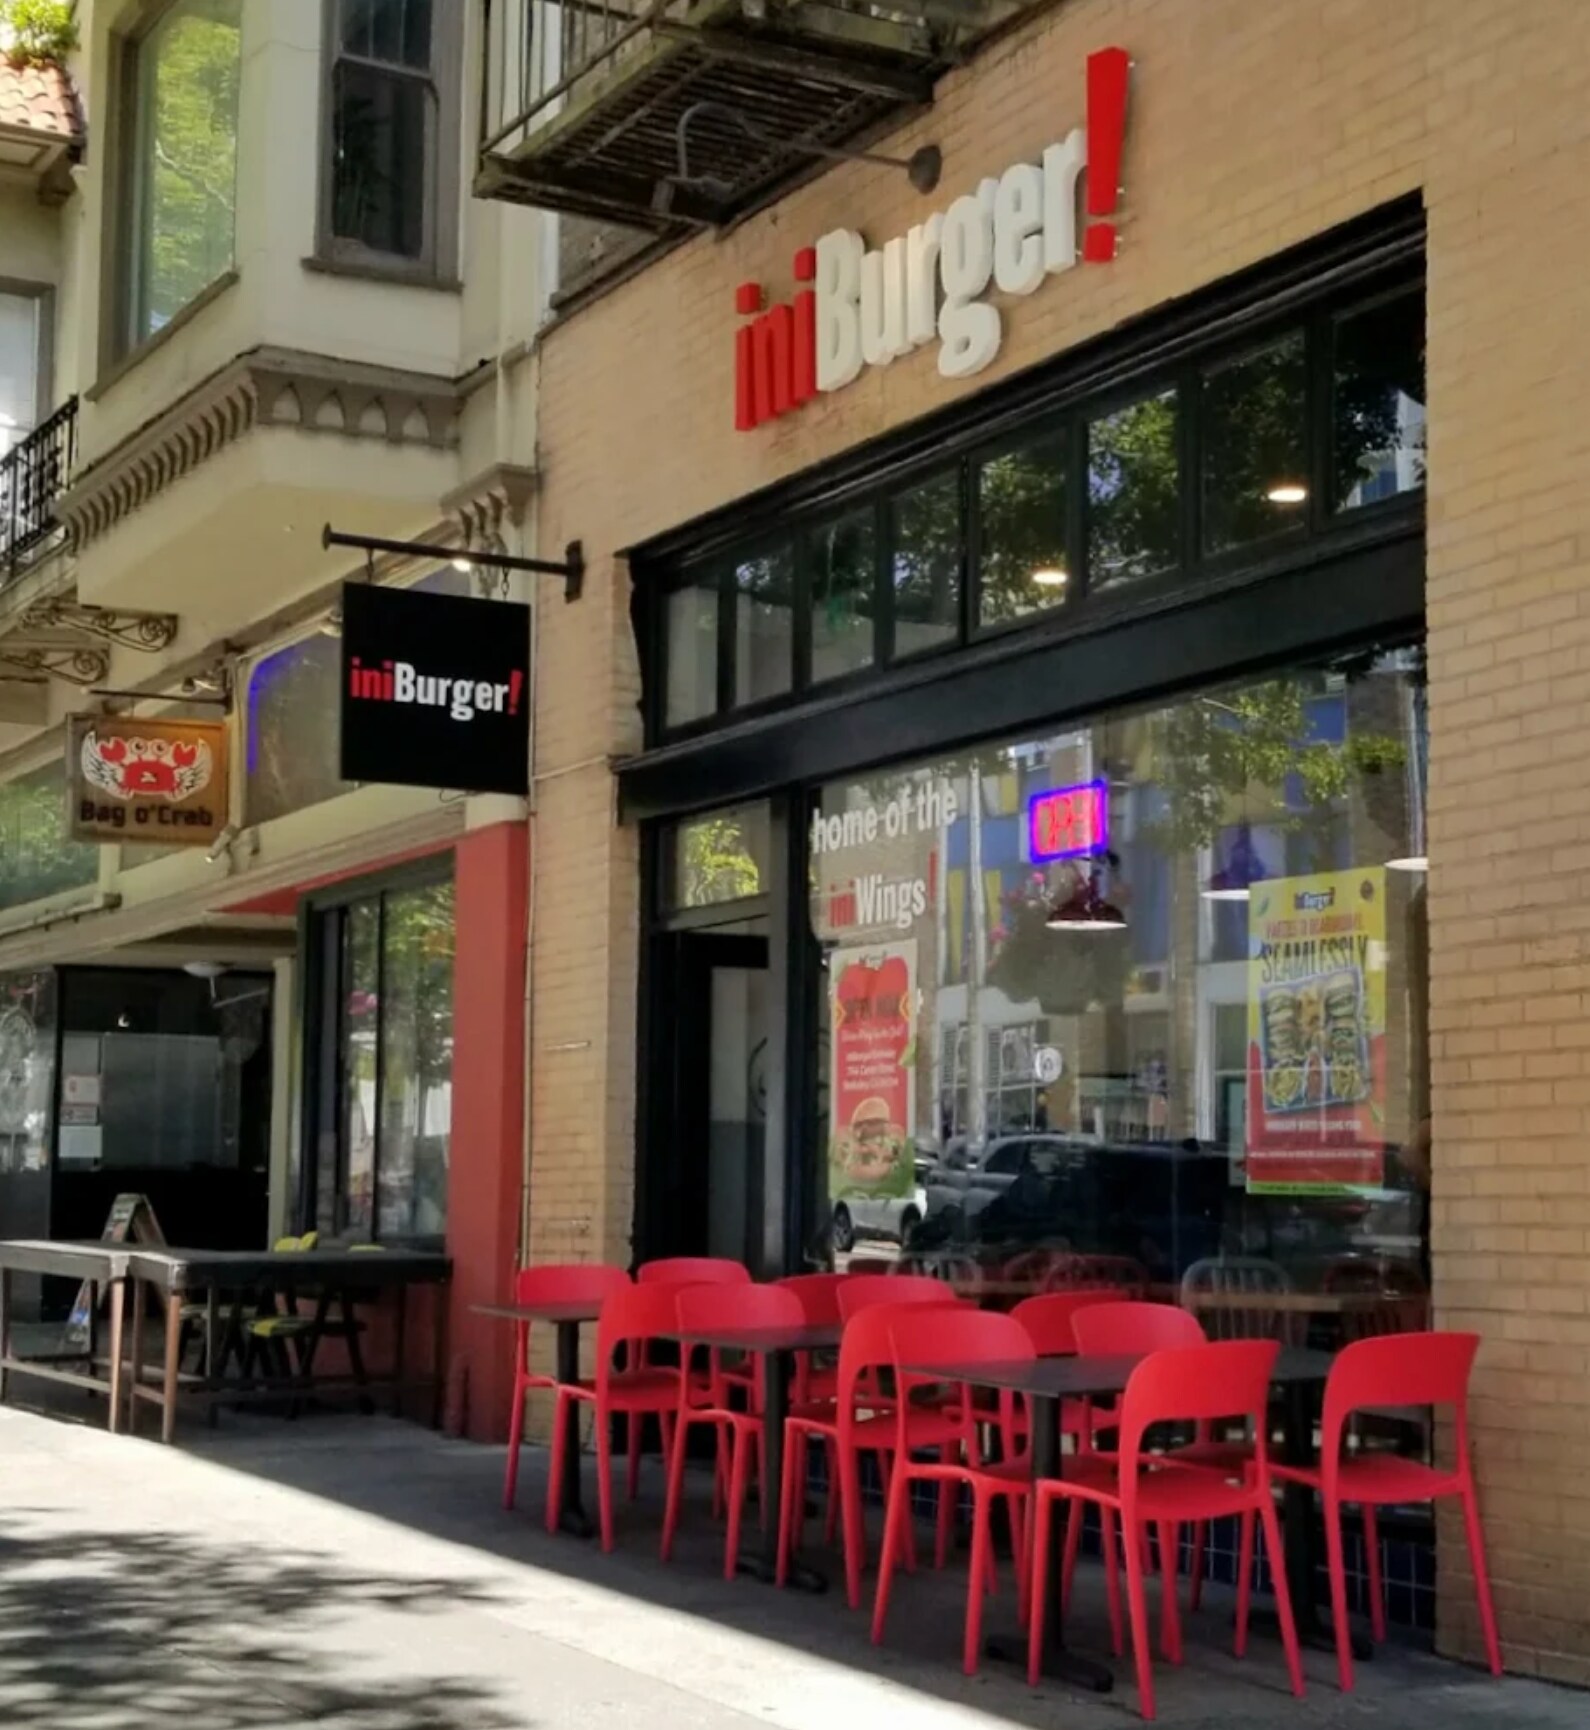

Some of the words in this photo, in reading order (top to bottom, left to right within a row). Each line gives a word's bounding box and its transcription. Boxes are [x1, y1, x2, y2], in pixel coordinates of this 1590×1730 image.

[734, 46, 1131, 431] iniBurger!
[351, 656, 523, 722] iniBurger!
[80, 801, 126, 828] Bag
[135, 804, 213, 827] o'Crab
[812, 807, 878, 854] home
[885, 783, 915, 838] of
[917, 779, 957, 832] the
